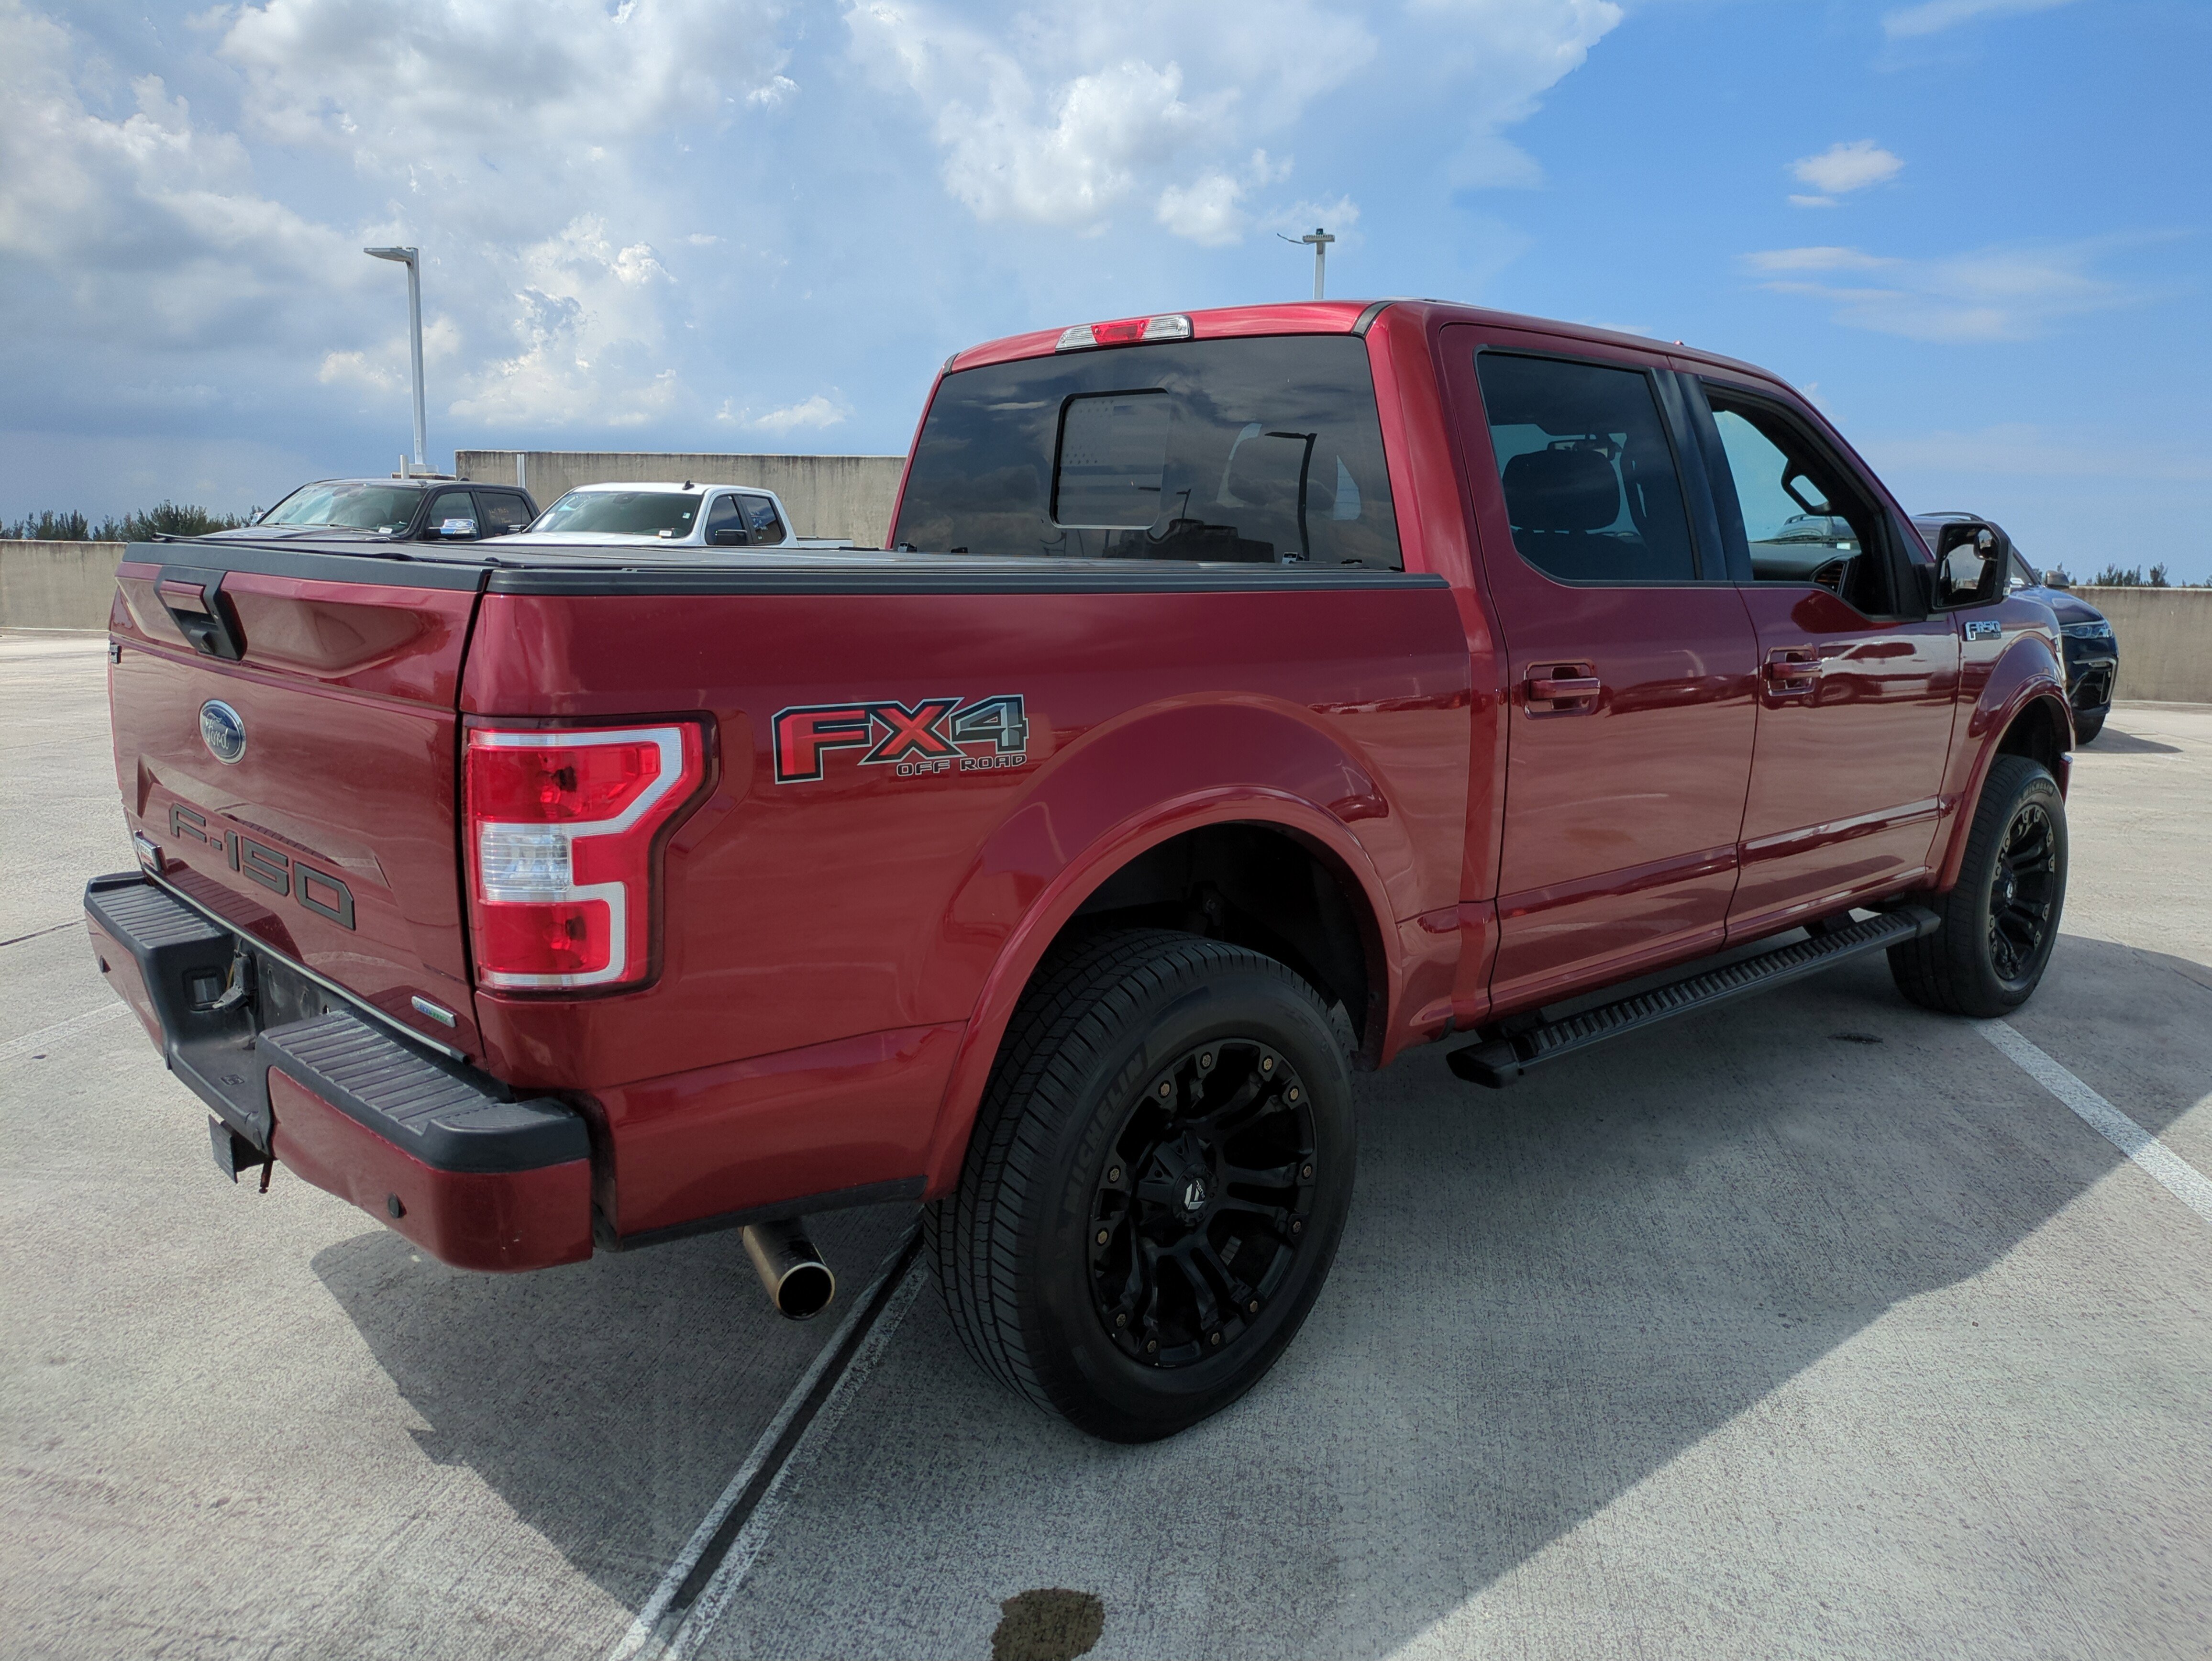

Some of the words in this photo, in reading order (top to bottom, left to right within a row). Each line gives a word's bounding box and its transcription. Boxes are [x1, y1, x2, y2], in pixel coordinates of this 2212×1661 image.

[205, 712, 230, 750] Ford
[772, 694, 1029, 785] FX4
[896, 760, 950, 776] OFF
[960, 754, 1027, 771] ROAD
[169, 803, 355, 930] F-150
[1062, 1049, 1146, 1215] MICHELIN
